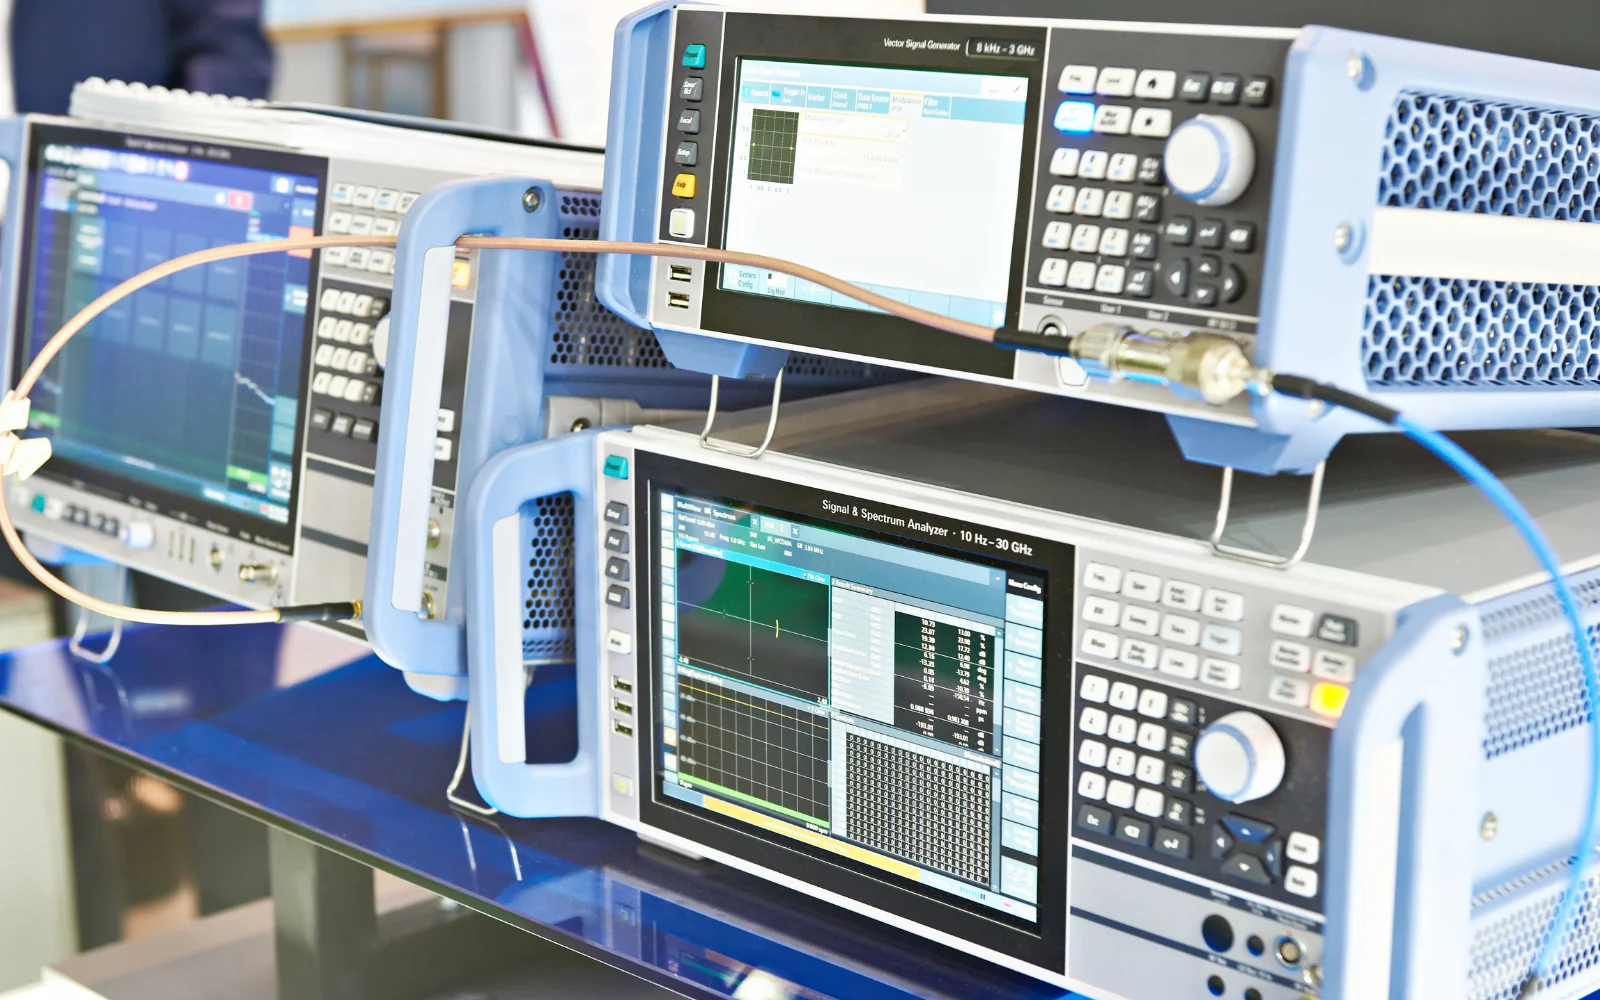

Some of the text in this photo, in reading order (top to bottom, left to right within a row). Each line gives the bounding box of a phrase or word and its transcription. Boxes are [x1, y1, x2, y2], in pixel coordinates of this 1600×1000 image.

[884, 38, 961, 51] Vector Signal Generator
[685, 50, 699, 58] Preset
[976, 43, 982, 53] 8
[984, 43, 1000, 54] kHz
[1008, 44, 1015, 56] 3
[1016, 45, 1035, 57] GHz
[807, 93, 826, 102] Marker
[833, 91, 848, 100] Clock
[858, 93, 890, 103] Data Source
[892, 96, 921, 105] Modulation
[676, 148, 691, 157] Setup
[675, 180, 687, 189] Help
[738, 270, 757, 279] System
[737, 279, 753, 290] Config
[1043, 296, 1065, 307] Sensor
[1101, 303, 1116, 313] User
[677, 500, 702, 513] MultiView
[712, 509, 737, 521] Spectrum
[822, 499, 850, 515] Signal
[851, 506, 859, 517] &
[861, 508, 905, 528] Spectrum
[907, 518, 948, 538] Analyzer
[960, 529, 973, 543] 10
[1011, 541, 1033, 556] GHz
[719, 533, 730, 543] Freq
[767, 535, 793, 547] 3G_WCDMA
[803, 544, 813, 552] 3.84
[813, 546, 824, 555] MHz
[835, 579, 851, 589] Result
[850, 583, 874, 596] Summary
[1127, 652, 1145, 664] Config
[976, 666, 987, 676] deg
[976, 675, 987, 684] deg
[978, 699, 986, 707] Hz
[975, 707, 988, 716] ppm
[1086, 813, 1100, 826] Esc
